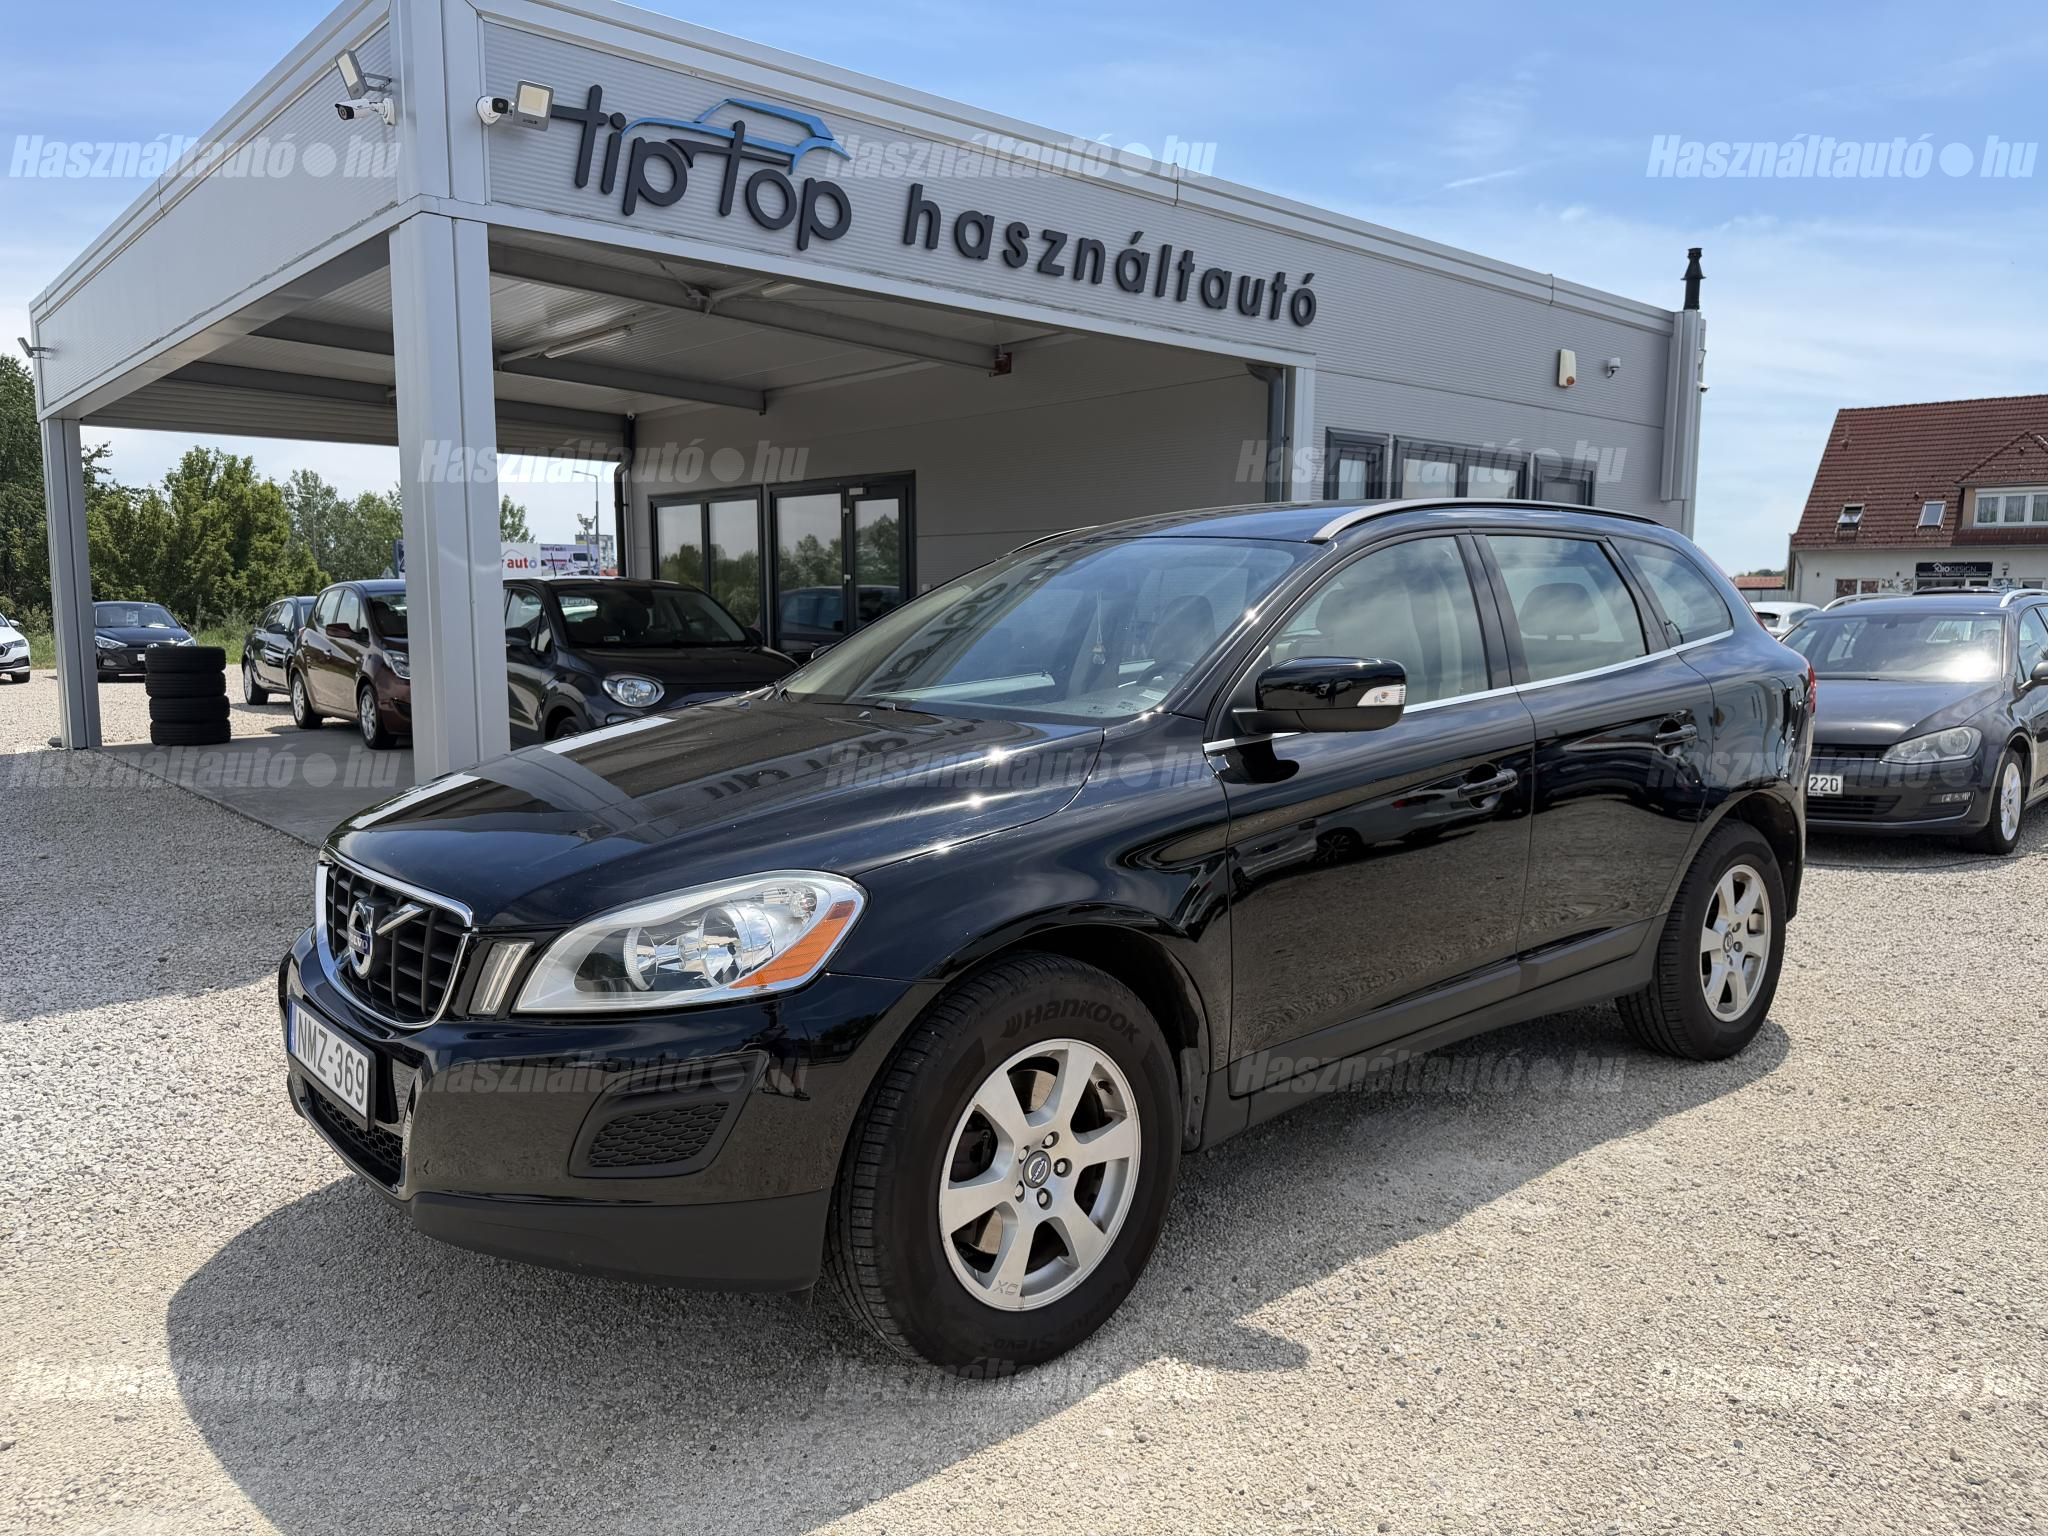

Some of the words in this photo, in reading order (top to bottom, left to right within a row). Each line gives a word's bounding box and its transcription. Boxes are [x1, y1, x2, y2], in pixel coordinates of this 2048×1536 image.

[903, 183, 1317, 327] használtautó
[1810, 776, 1839, 792] 220
[298, 1012, 365, 1106] NMZ-369
